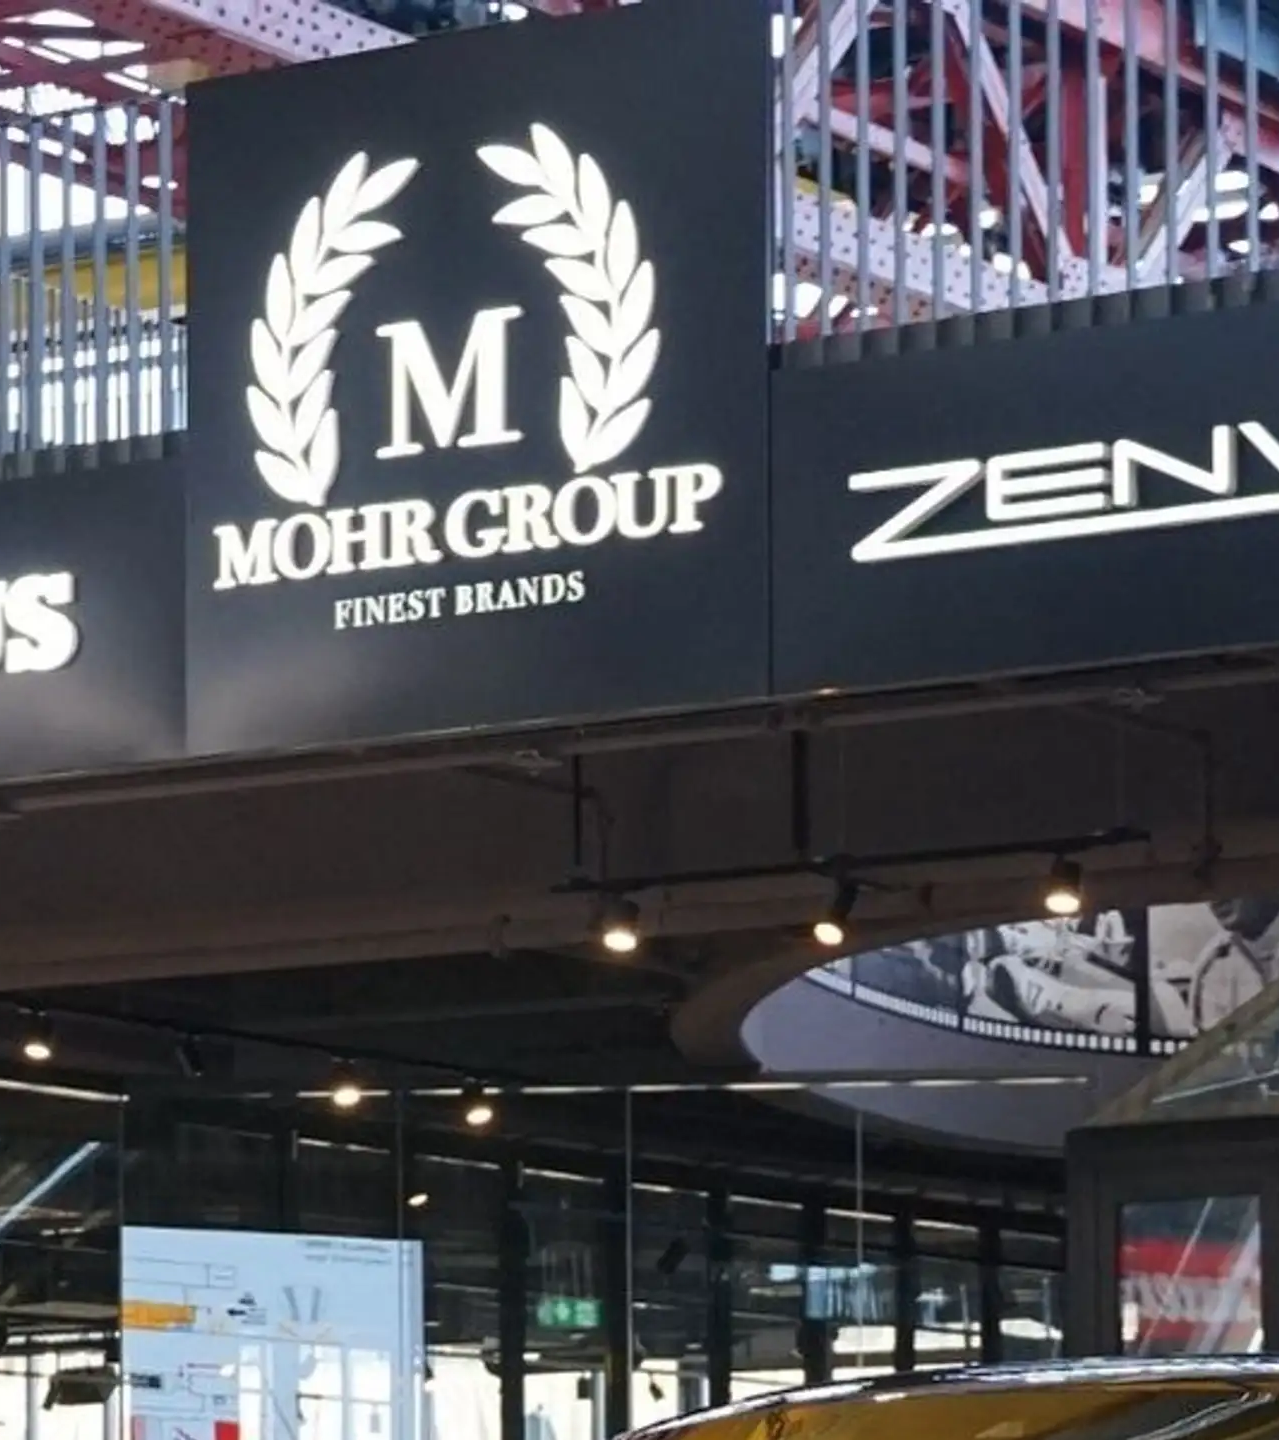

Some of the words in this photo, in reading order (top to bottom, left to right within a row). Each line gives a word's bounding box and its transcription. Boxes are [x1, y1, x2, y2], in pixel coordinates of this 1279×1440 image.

[374, 304, 524, 460] M
[212, 500, 443, 591] MOHR
[443, 463, 723, 559] GROUP
[333, 586, 447, 631] FINEST
[454, 570, 587, 617] BRANDS
